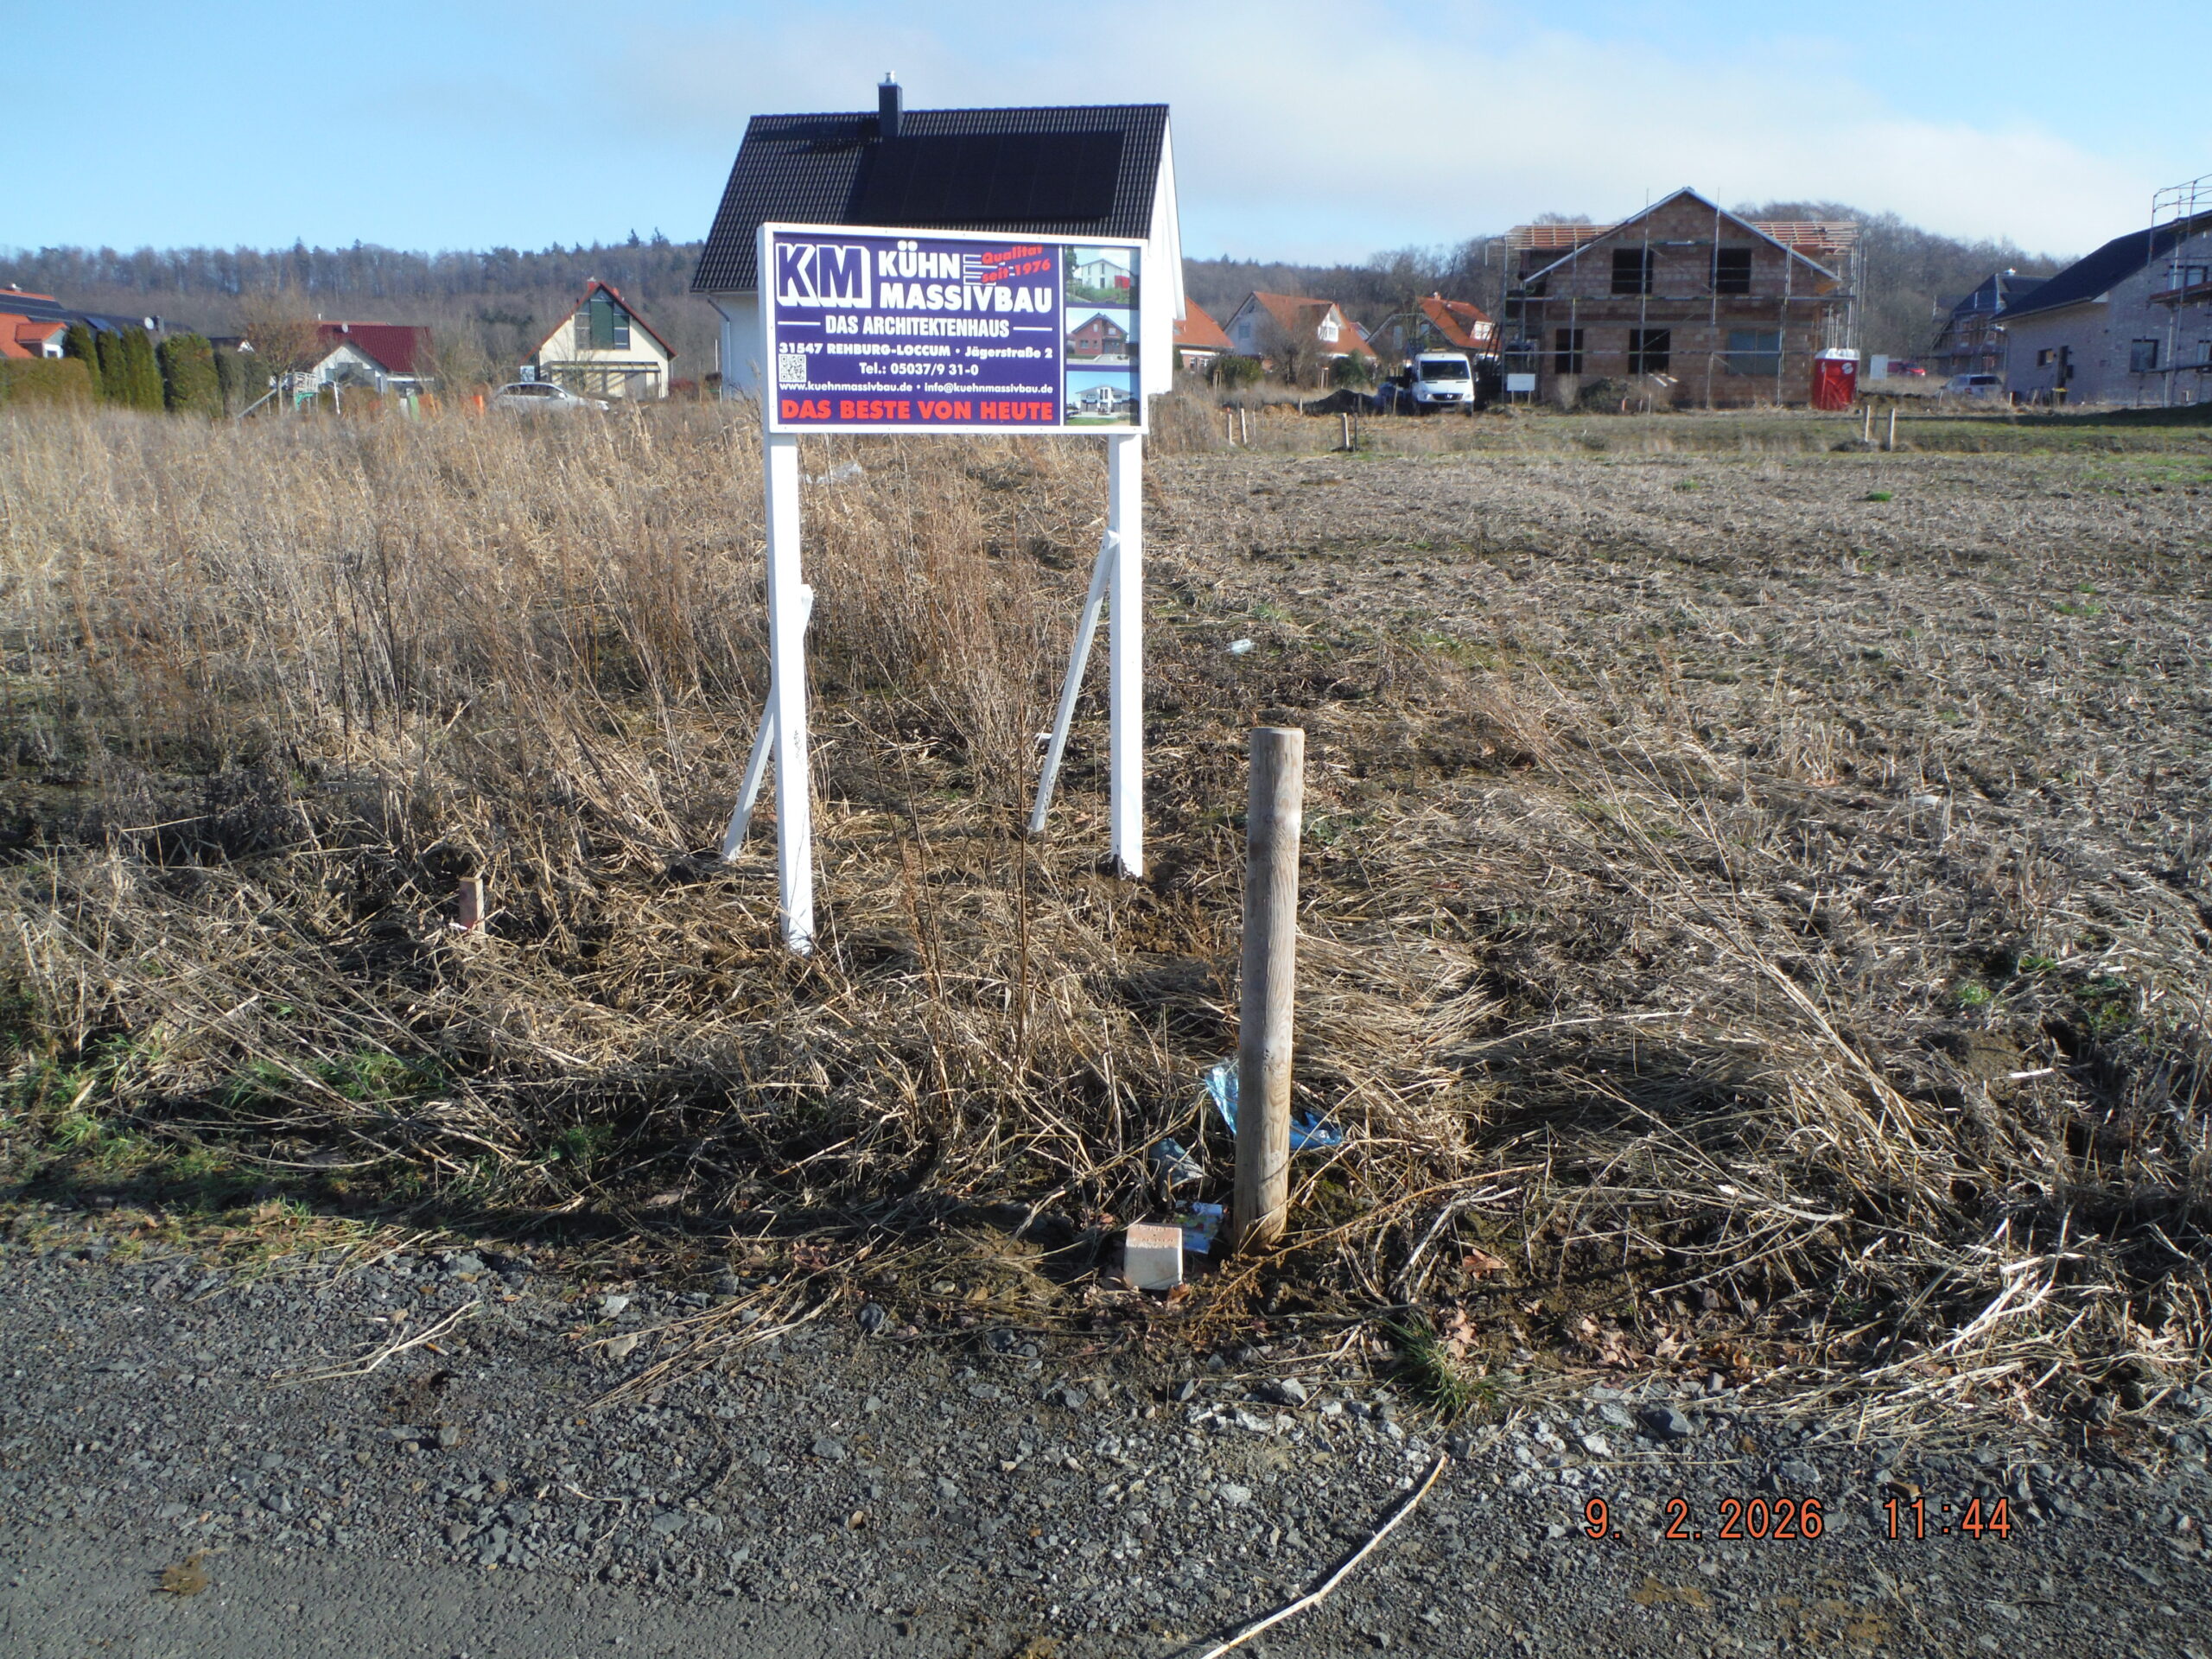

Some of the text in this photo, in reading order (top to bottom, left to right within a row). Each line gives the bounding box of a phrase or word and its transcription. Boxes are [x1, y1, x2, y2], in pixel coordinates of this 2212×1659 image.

[878, 240, 961, 279] KÜHN
[981, 258, 1052, 283] seit 1976
[880, 283, 1052, 313] MASSIVBAU
[825, 315, 1010, 338] DAS ARCHITEKTENHAUS
[779, 342, 1053, 359] 31547 REHBURG-LOCCUM Jägerstraße 2
[859, 362, 979, 376] Tel.: 05037/9 31-0
[779, 381, 1053, 394] www.kuehnmassivbau.de info@kuehnmassivbau.de
[781, 399, 1053, 421] DAS BESTE VON HEUTE
